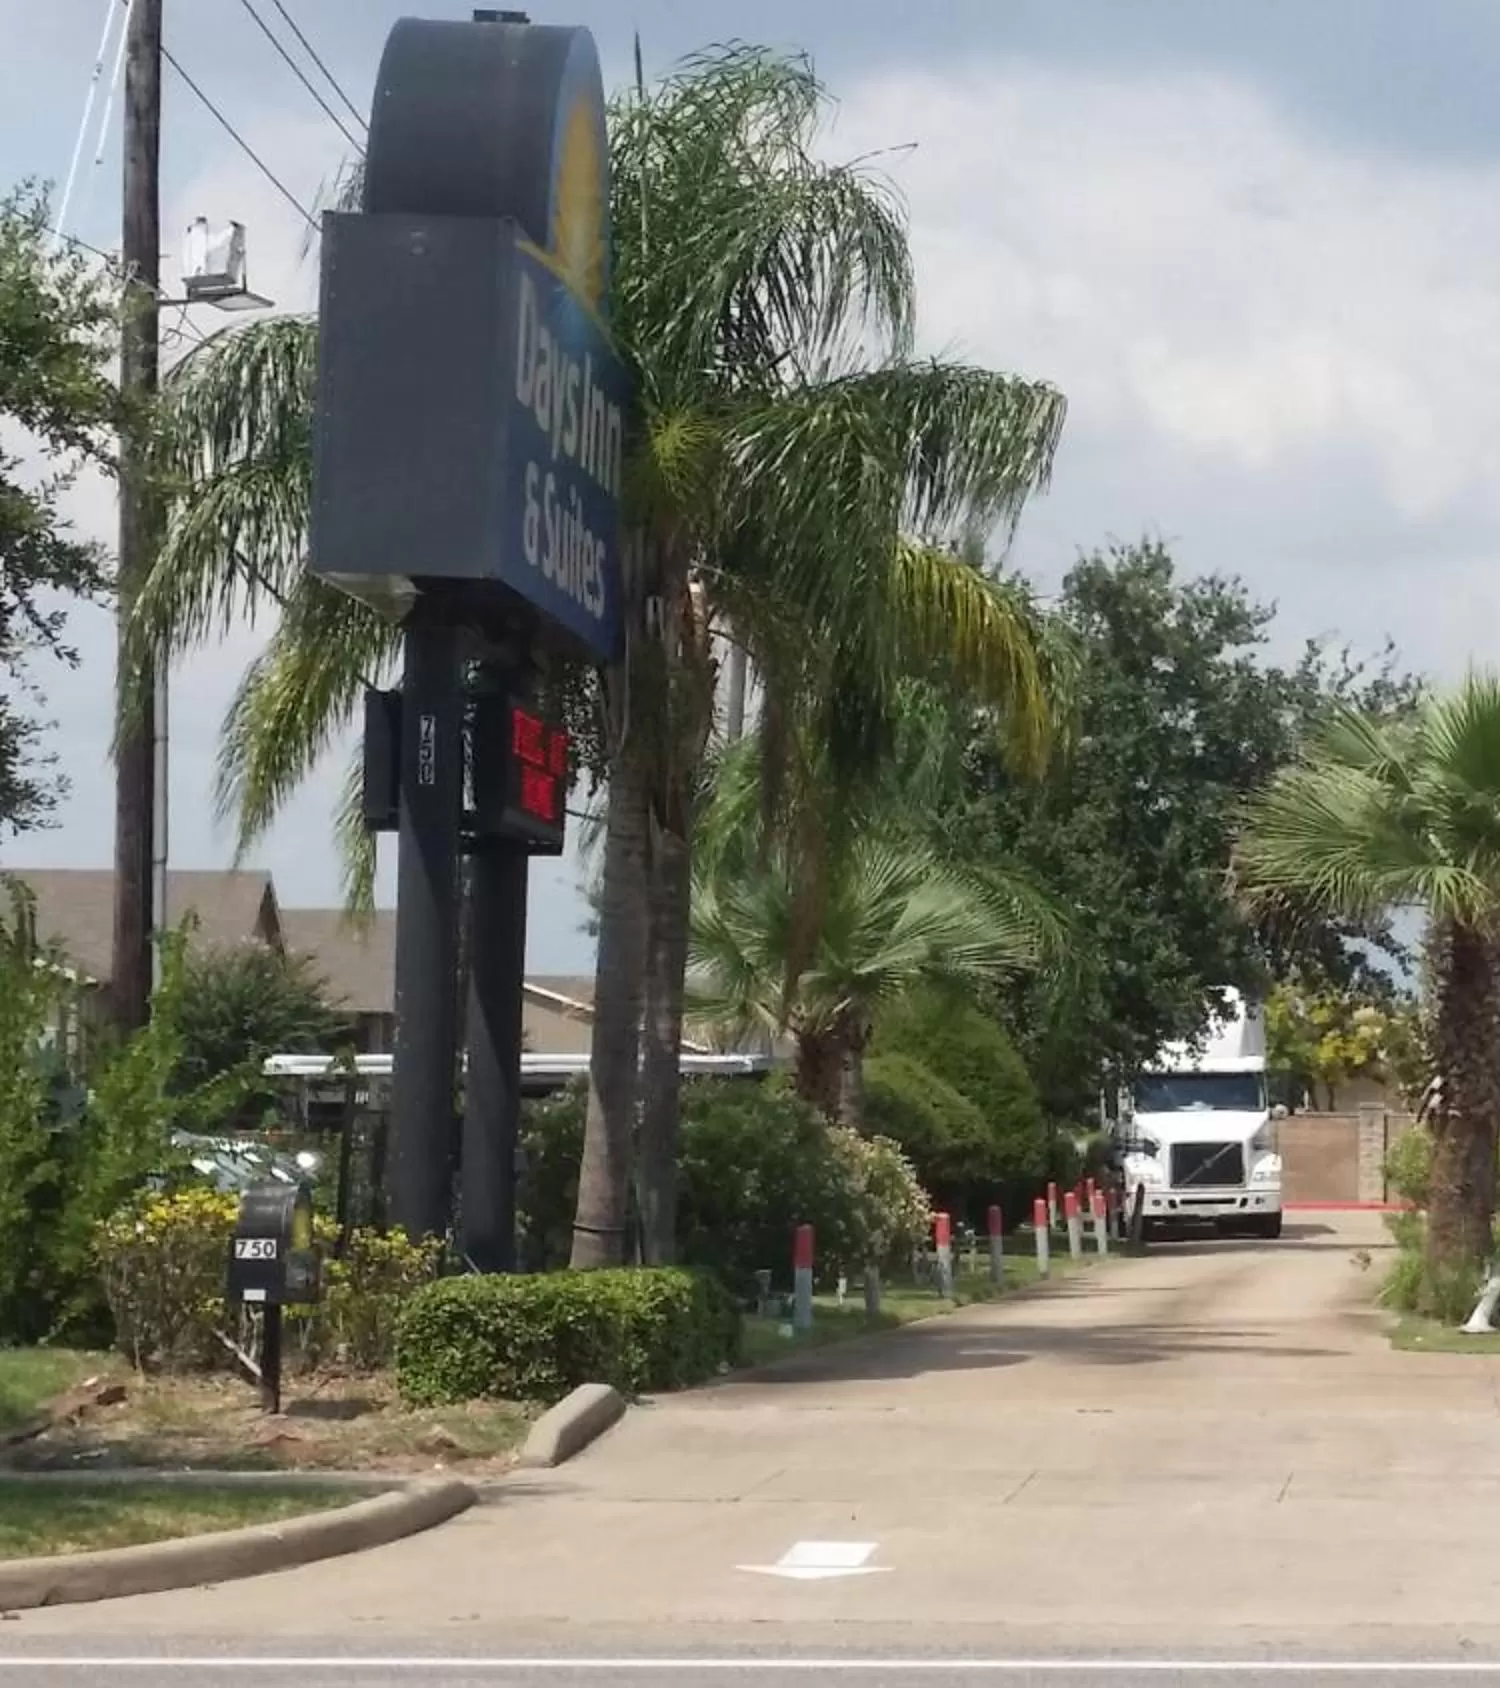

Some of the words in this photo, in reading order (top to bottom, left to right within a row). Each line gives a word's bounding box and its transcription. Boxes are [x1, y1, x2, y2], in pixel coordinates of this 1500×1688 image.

[515, 271, 580, 460] Days
[580, 351, 622, 498] Inn
[542, 471, 607, 620] Suites
[236, 1241, 275, 1257] 750
